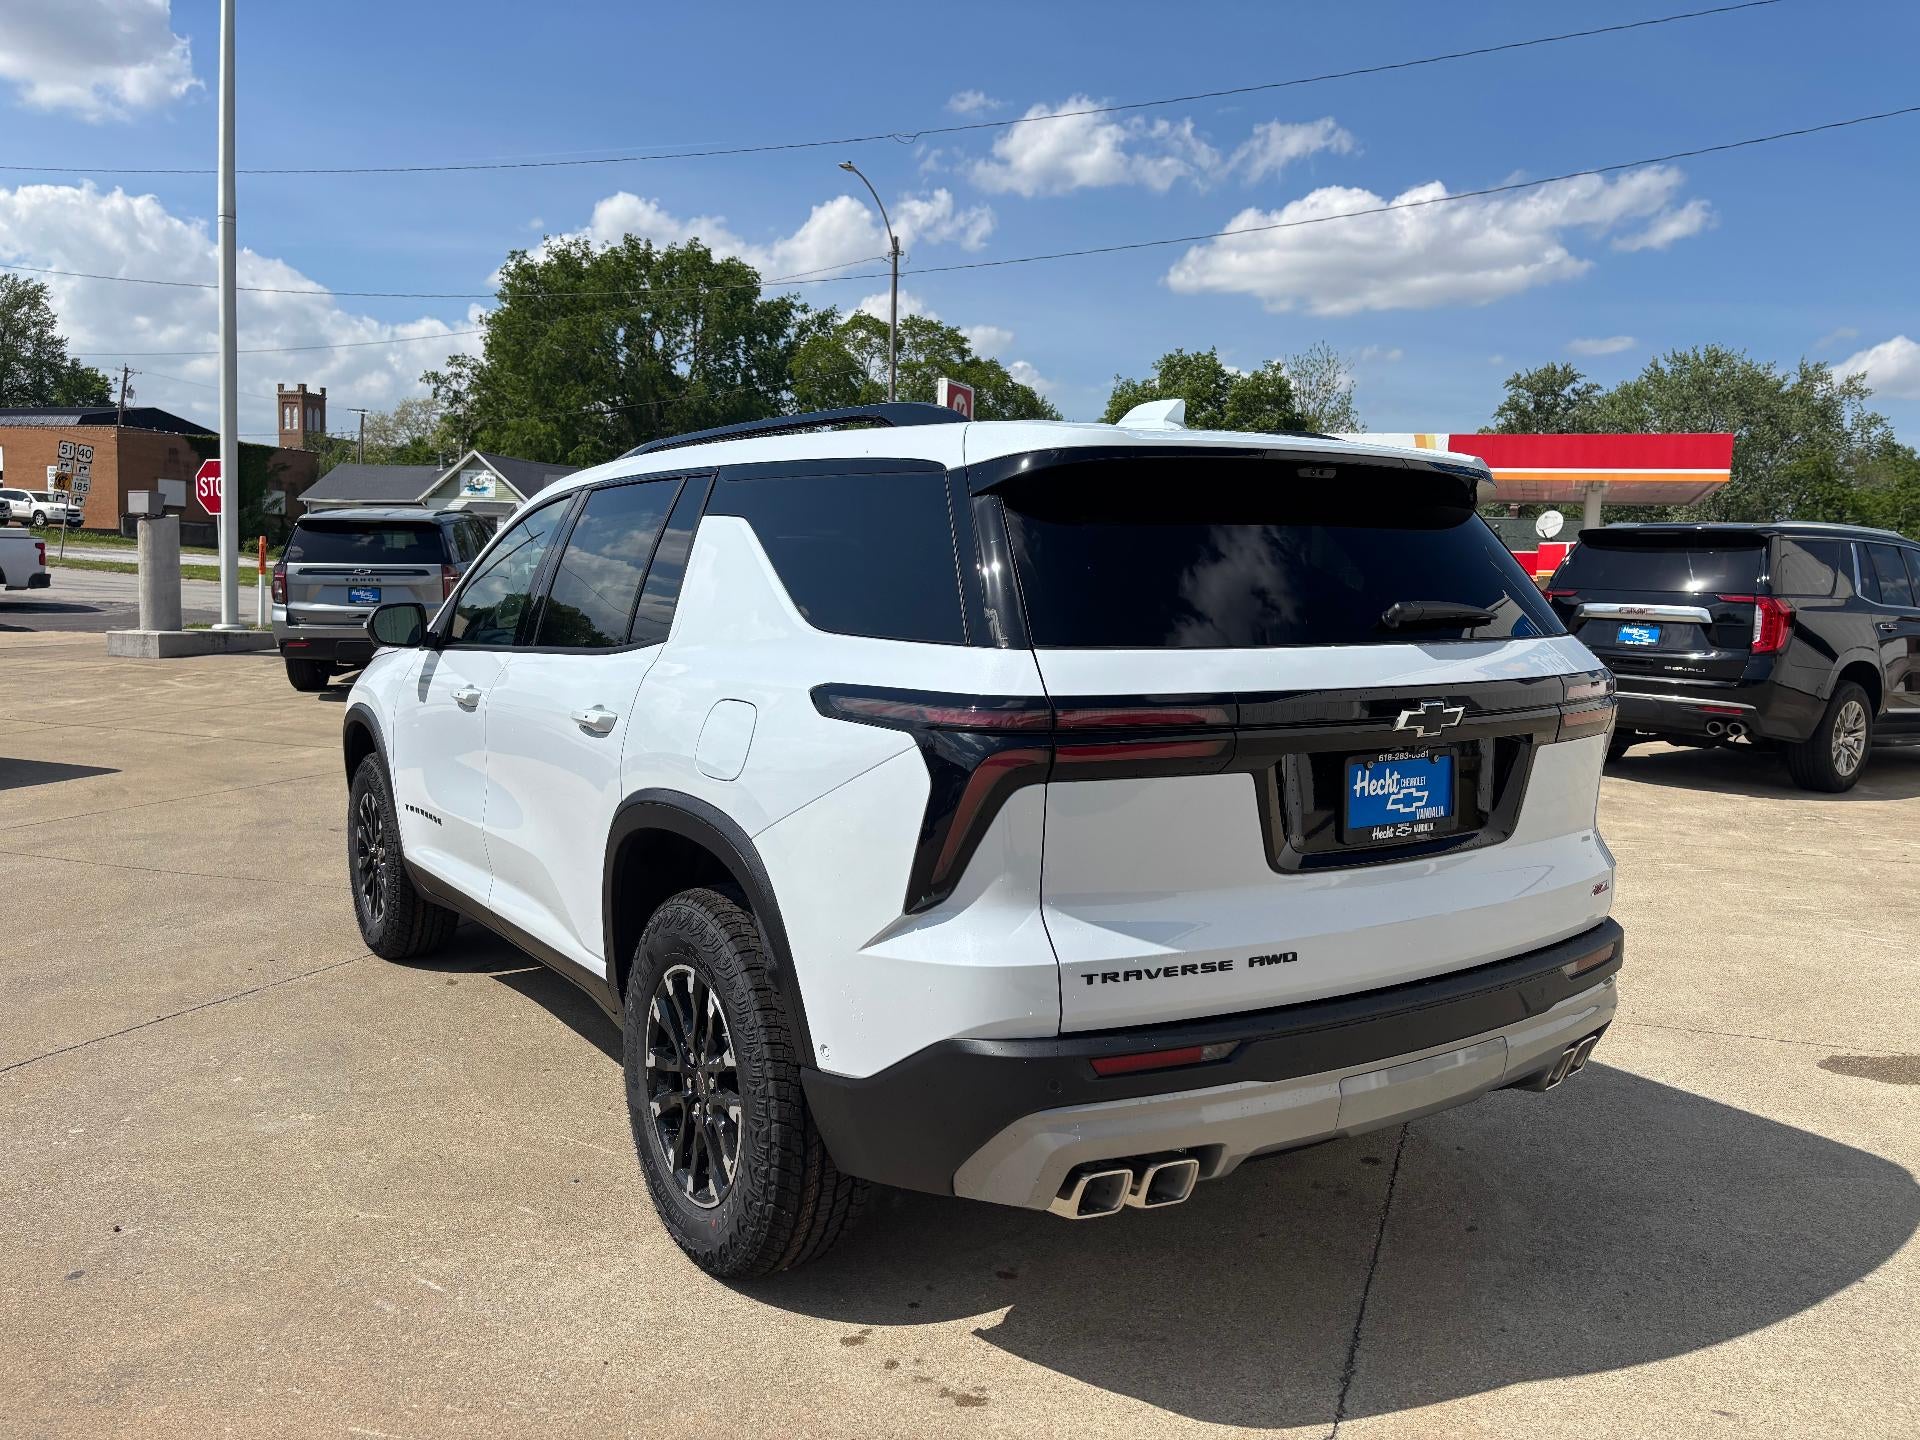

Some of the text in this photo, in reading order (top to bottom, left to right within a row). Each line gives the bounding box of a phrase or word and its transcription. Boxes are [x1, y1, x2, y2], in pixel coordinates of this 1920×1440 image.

[61, 444, 73, 456] 51
[78, 448, 91, 459] 40
[73, 481, 88, 492] 185
[200, 476, 222, 497] STO
[1353, 767, 1401, 798] Hecht
[1416, 805, 1445, 820] VANDALIA
[1372, 825, 1395, 840] Hecht
[1081, 951, 1298, 986] TRAVERSE AWD
